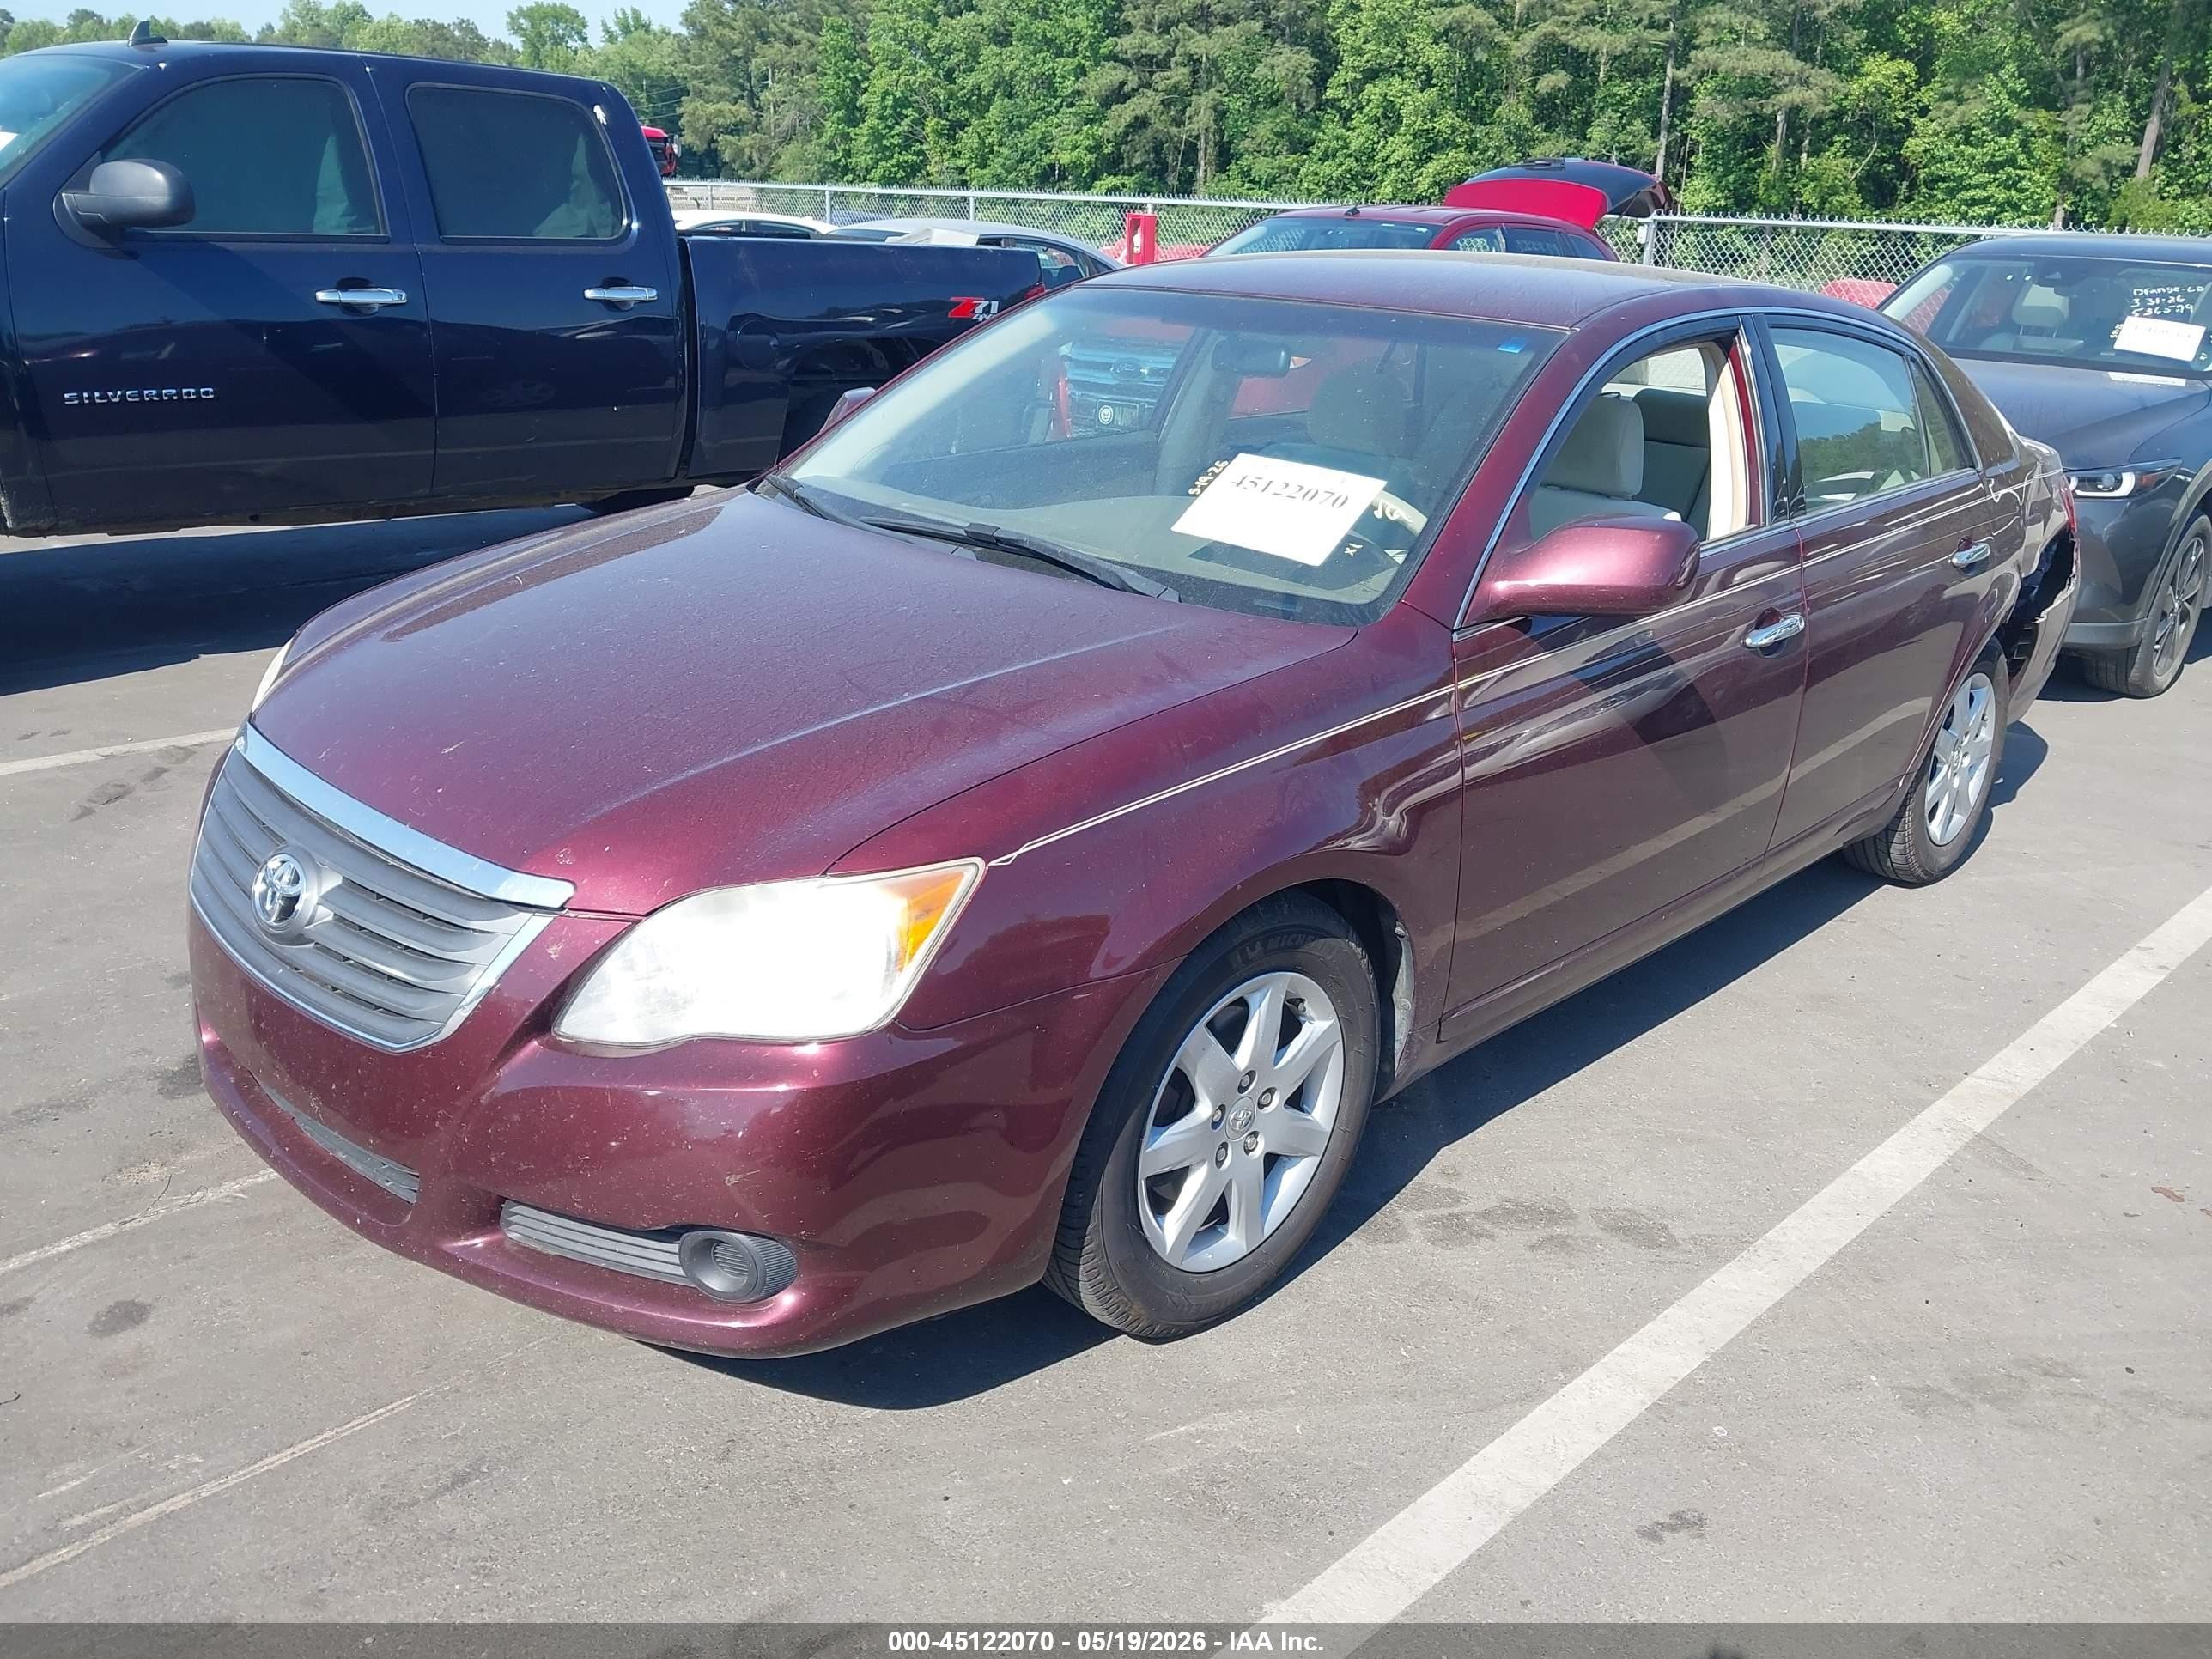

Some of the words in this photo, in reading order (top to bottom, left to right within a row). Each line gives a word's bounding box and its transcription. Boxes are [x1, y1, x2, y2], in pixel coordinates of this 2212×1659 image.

[948, 296, 1000, 319] Z71
[64, 387, 215, 404] SILVERADO
[1231, 474, 1349, 509] 45122070
